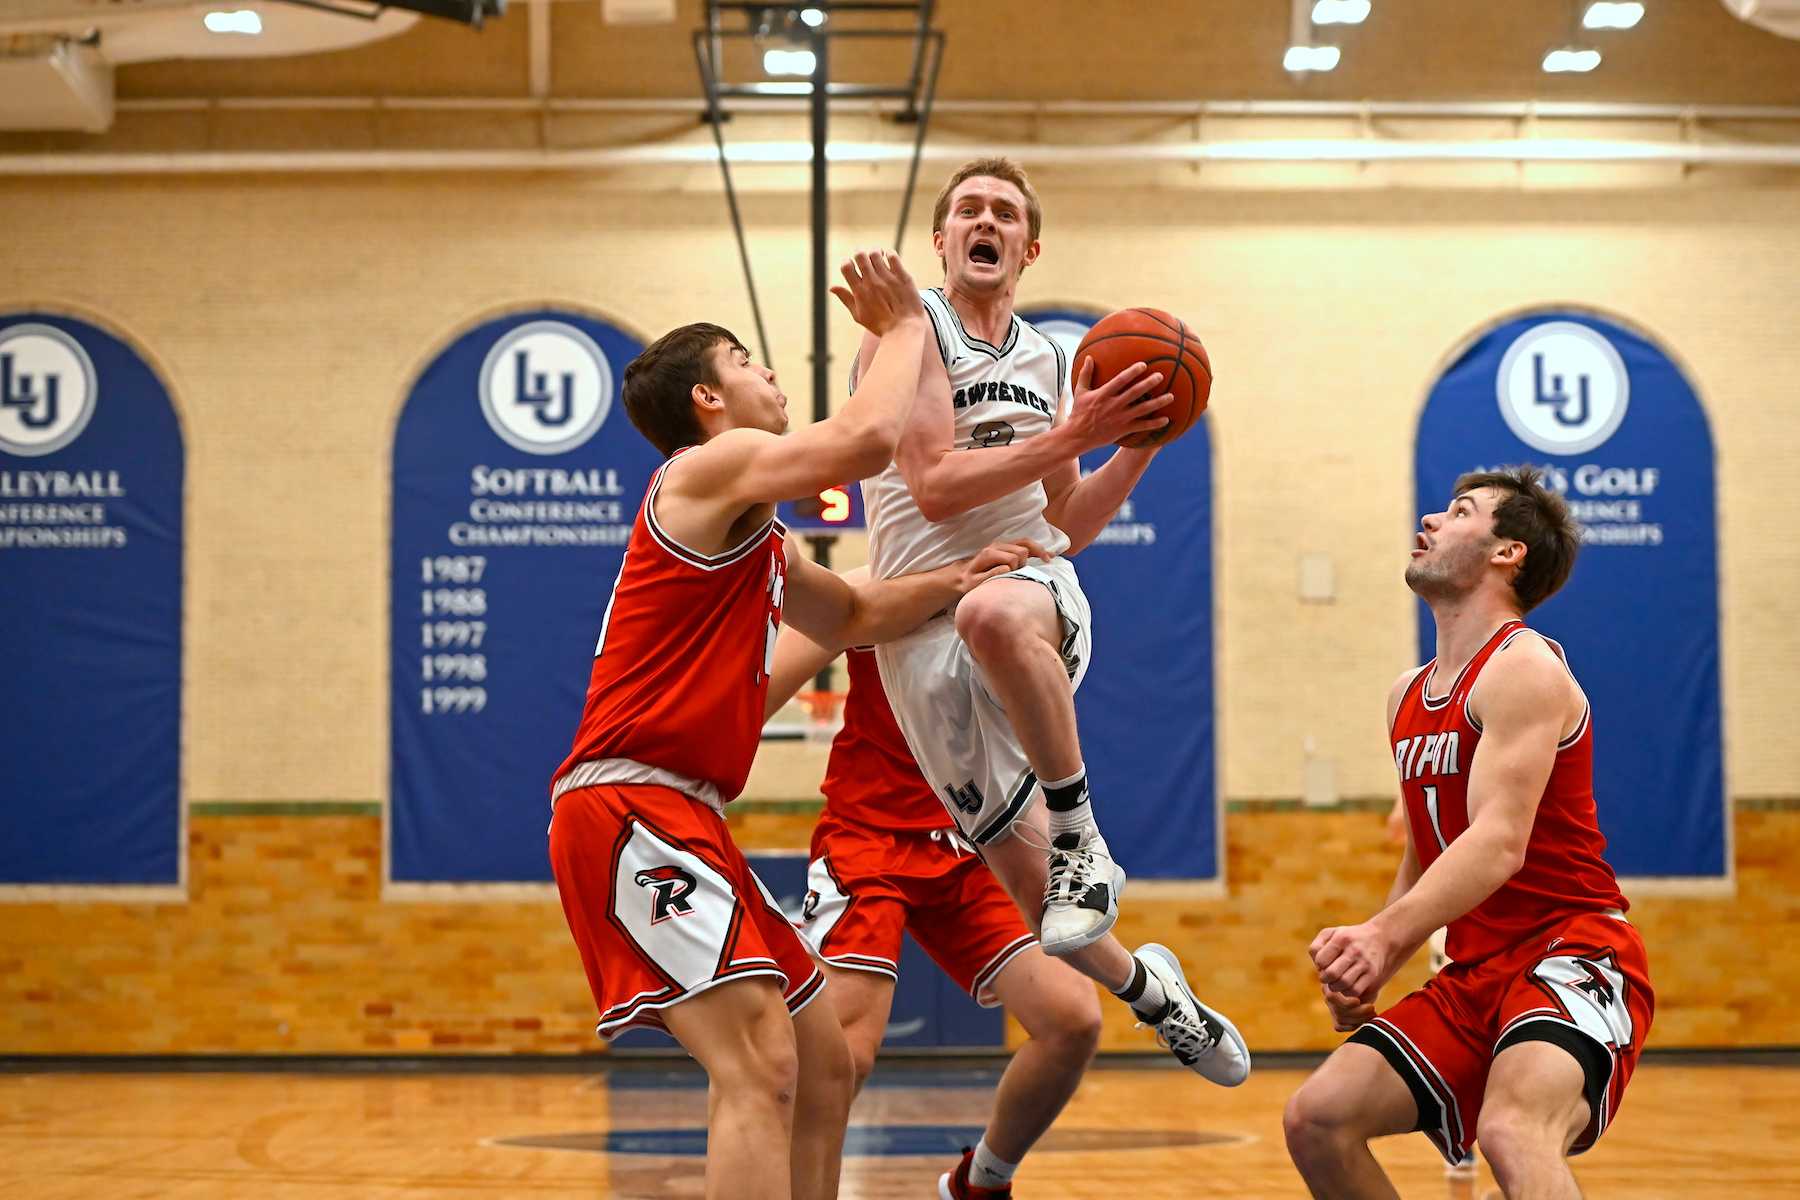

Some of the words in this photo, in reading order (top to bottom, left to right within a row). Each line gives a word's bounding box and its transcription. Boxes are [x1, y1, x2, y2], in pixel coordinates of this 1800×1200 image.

[515, 351, 575, 427] LU
[1533, 352, 1591, 427] LU
[471, 465, 624, 496] SOFTBALL
[1573, 464, 1660, 496] GOLF
[470, 498, 623, 523] CONFERENCE
[0, 526, 128, 548] PIONSHIPS
[448, 521, 632, 547] CHAMPIONSHIP
[422, 555, 487, 583] 1987
[422, 588, 487, 617] 1988
[422, 621, 487, 649] 1997
[422, 653, 487, 682] 1998
[422, 686, 487, 714] 1999
